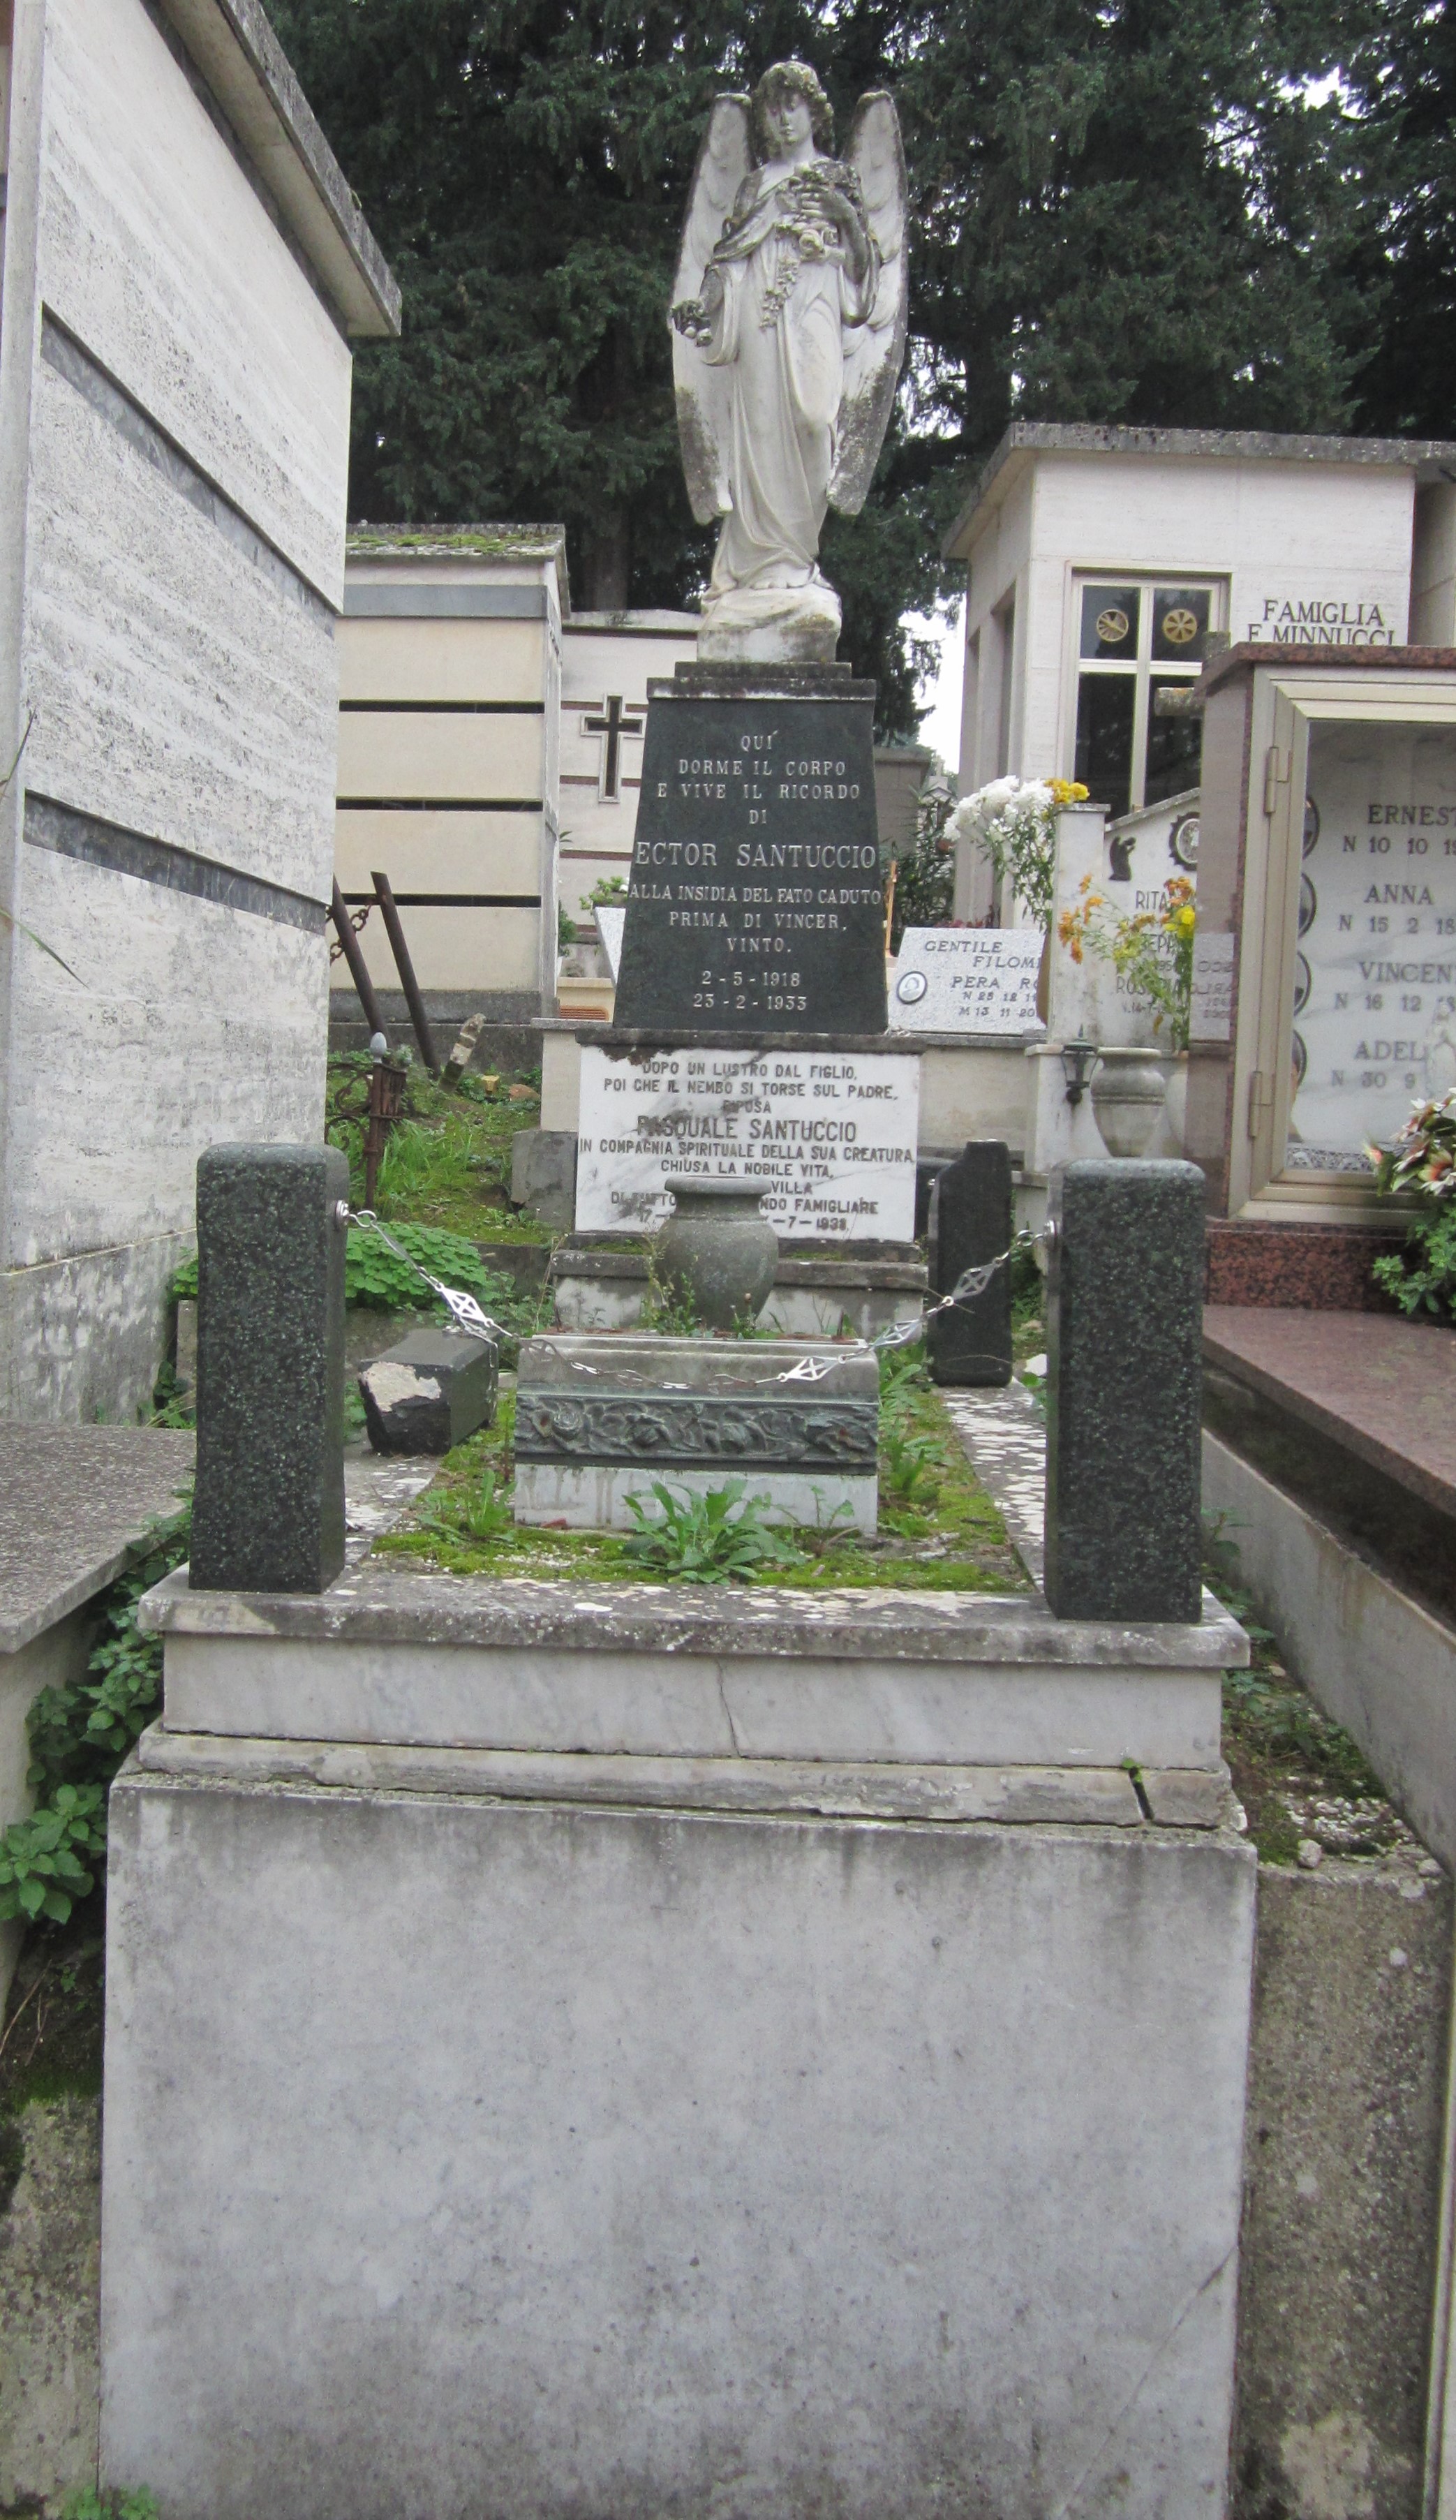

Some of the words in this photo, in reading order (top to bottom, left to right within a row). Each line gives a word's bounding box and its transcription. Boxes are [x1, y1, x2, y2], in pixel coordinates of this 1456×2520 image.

[1263, 600, 1384, 627] FAMIGLIA
[1273, 625, 1395, 646] MINNUCCI
[678, 759, 743, 775] DORME
[753, 760, 772, 776] IL
[786, 761, 846, 776] CORPO
[658, 783, 667, 798] E
[682, 784, 727, 799] VIVE
[743, 785, 762, 799] IL
[780, 785, 860, 799] RICORDO
[749, 810, 767, 824] DI
[635, 841, 718, 866] ECTOR
[736, 844, 876, 868] SANTUCCIO
[1343, 836, 1356, 852] N
[1369, 836, 1391, 854] 10
[1408, 838, 1428, 855] 10
[629, 884, 672, 900] ALLA
[678, 886, 738, 902] INSIDIA
[743, 888, 773, 903] DEL
[777, 889, 812, 904] FATO
[817, 889, 882, 905] CADUTO
[1364, 884, 1434, 905] ANNA
[669, 912, 729, 928] PRIMA
[744, 913, 761, 928] DI
[1338, 914, 1352, 931] N
[1406, 917, 1418, 934] 2
[727, 937, 792, 953] VINTO.
[925, 940, 1003, 953] GENTILE
[1359, 961, 1456, 984] VINCEN
[951, 976, 1000, 988] PERA
[1334, 992, 1348, 1010] N
[1402, 994, 1422, 1011] 12
[1019, 1009, 1035, 1017] 20
[1354, 1040, 1426, 1061] ADEL
[642, 1062, 679, 1074] DOPO
[688, 1062, 705, 1075] UN
[713, 1062, 767, 1077] LUSTRO
[775, 1065, 801, 1078] DAL
[1332, 1069, 1344, 1087] N
[604, 1078, 625, 1091] POI
[634, 1079, 660, 1092] CHE
[668, 1080, 679, 1092] IL
[688, 1081, 732, 1094] NEMBO
[741, 1083, 752, 1095] SI
[762, 1083, 805, 1096] TORSE
[813, 1084, 840, 1097] SUL
[848, 1085, 898, 1100] PADRE,
[749, 1118, 856, 1142] SANTUCCIO
[580, 1139, 591, 1152] IN
[600, 1139, 673, 1155] COMPAGNIA
[678, 1141, 755, 1157] SPIRITUALE
[762, 1145, 804, 1159] DELLA
[811, 1146, 837, 1160] SUA
[844, 1147, 914, 1163] CREATURA
[661, 1159, 710, 1173] CHIUSA
[718, 1162, 736, 1173] LA
[745, 1162, 793, 1176] NOBILE
[771, 1180, 812, 1194] VILLA
[759, 1198, 787, 1210] NDO
[795, 1199, 879, 1215] FAMIGLIARE
